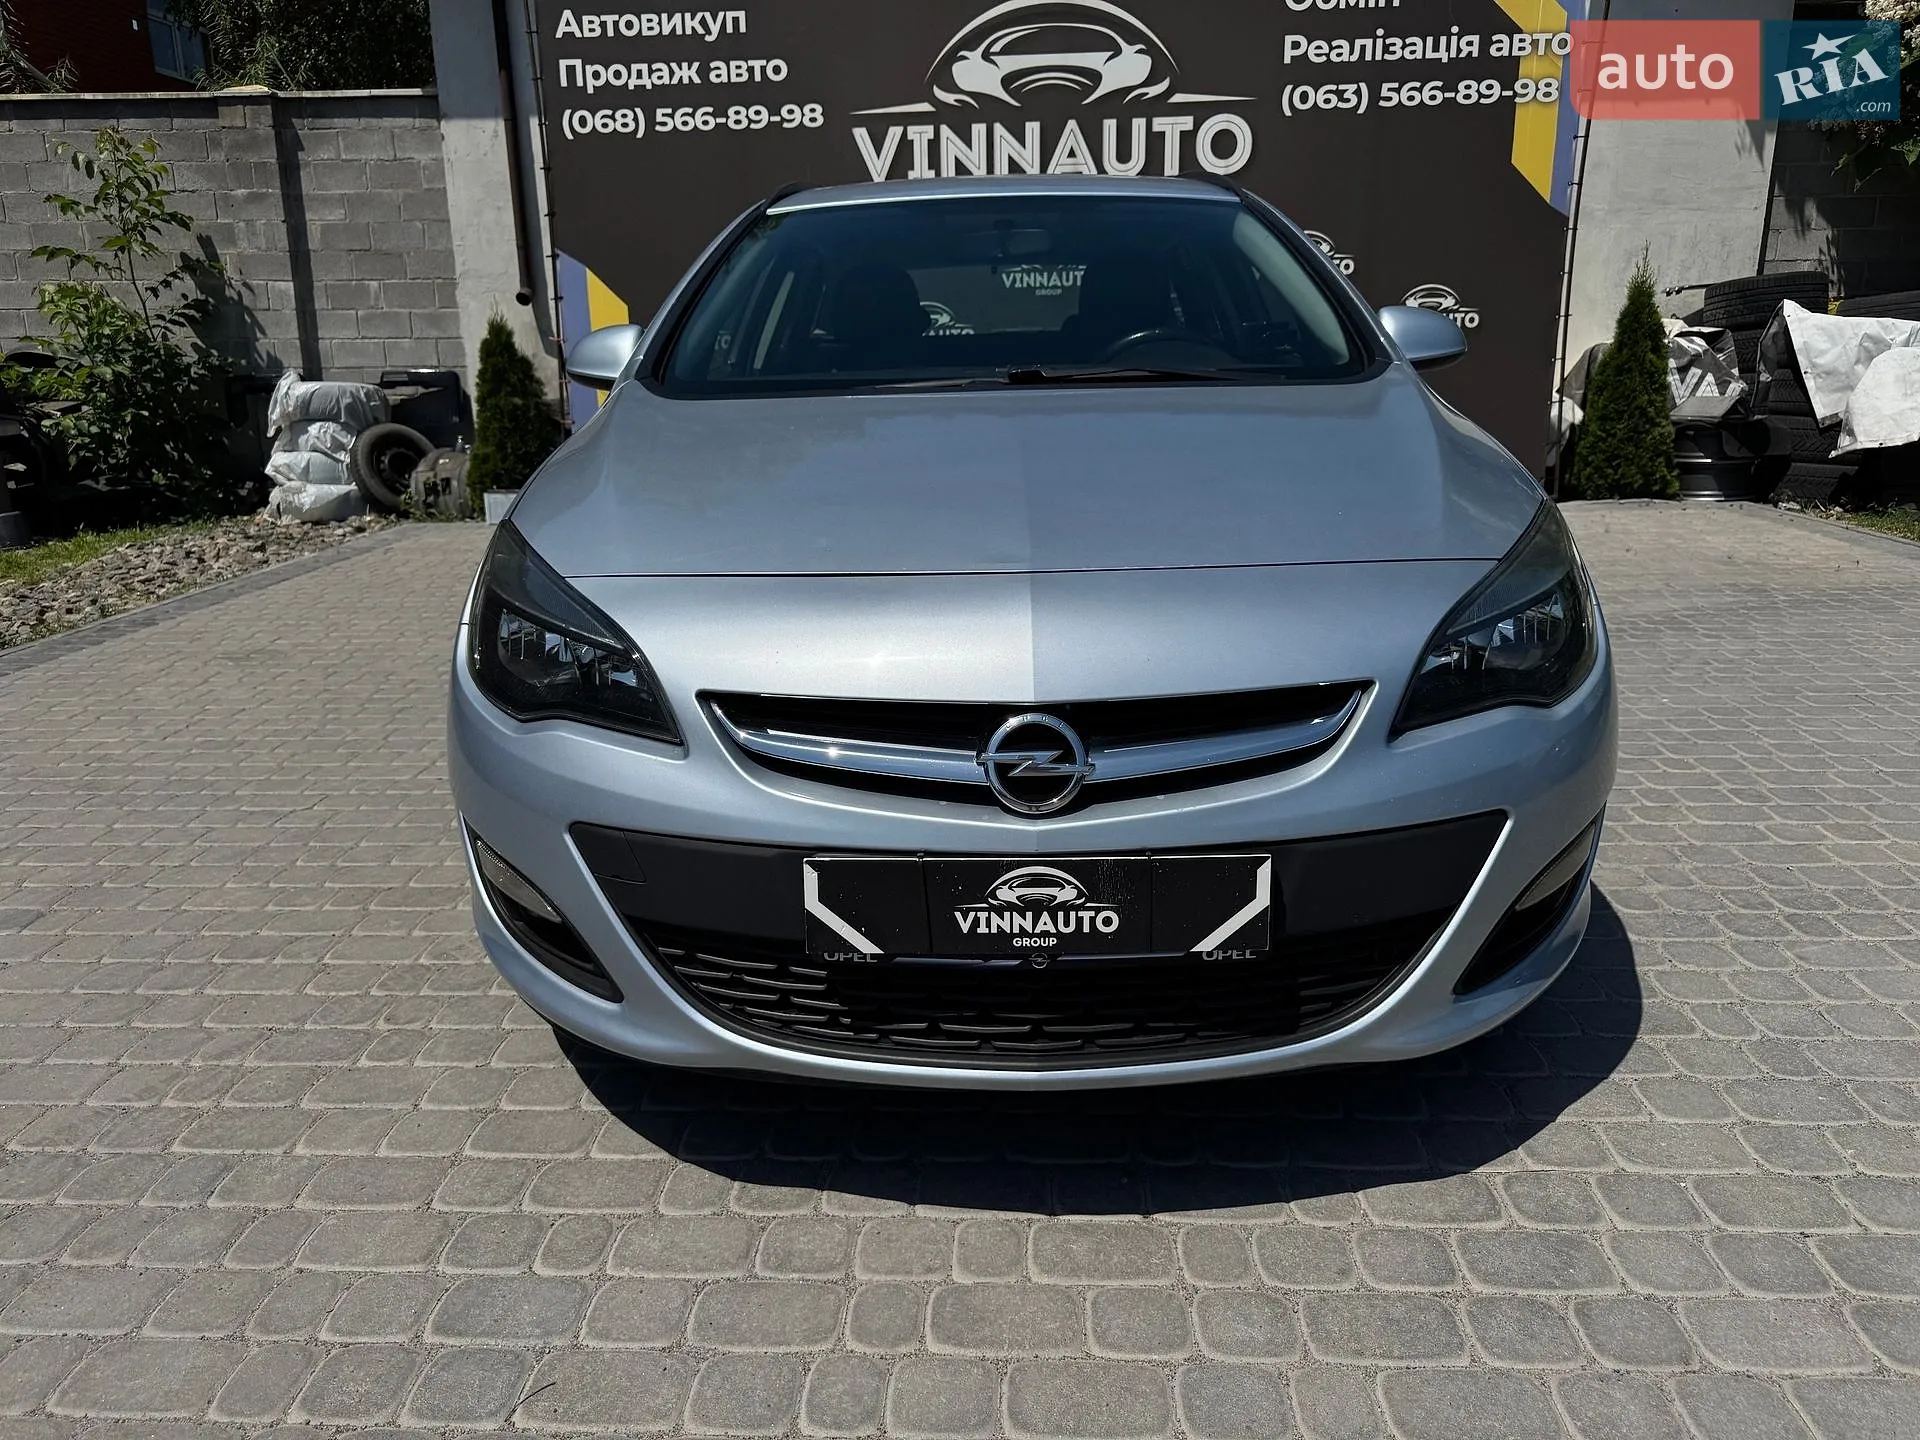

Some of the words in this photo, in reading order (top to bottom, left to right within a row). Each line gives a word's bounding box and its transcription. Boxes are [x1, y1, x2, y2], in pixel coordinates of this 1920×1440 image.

[555, 9, 747, 42] Автовикуп
[1282, 25, 1480, 64] Реалізація
[1489, 32, 1575, 57] авто
[558, 58, 702, 94] Продаж
[709, 58, 788, 84] авто
[1281, 82, 1369, 117] (063)
[1378, 77, 1560, 107] 566-89-98
[561, 107, 646, 140] (068)
[654, 103, 825, 132] 566-89-98
[851, 113, 1254, 182] VINNAUTO
[1001, 270, 1085, 289] VINNAUT
[953, 910, 1120, 934] VINNAUTO
[1012, 937, 1058, 947] GROUP
